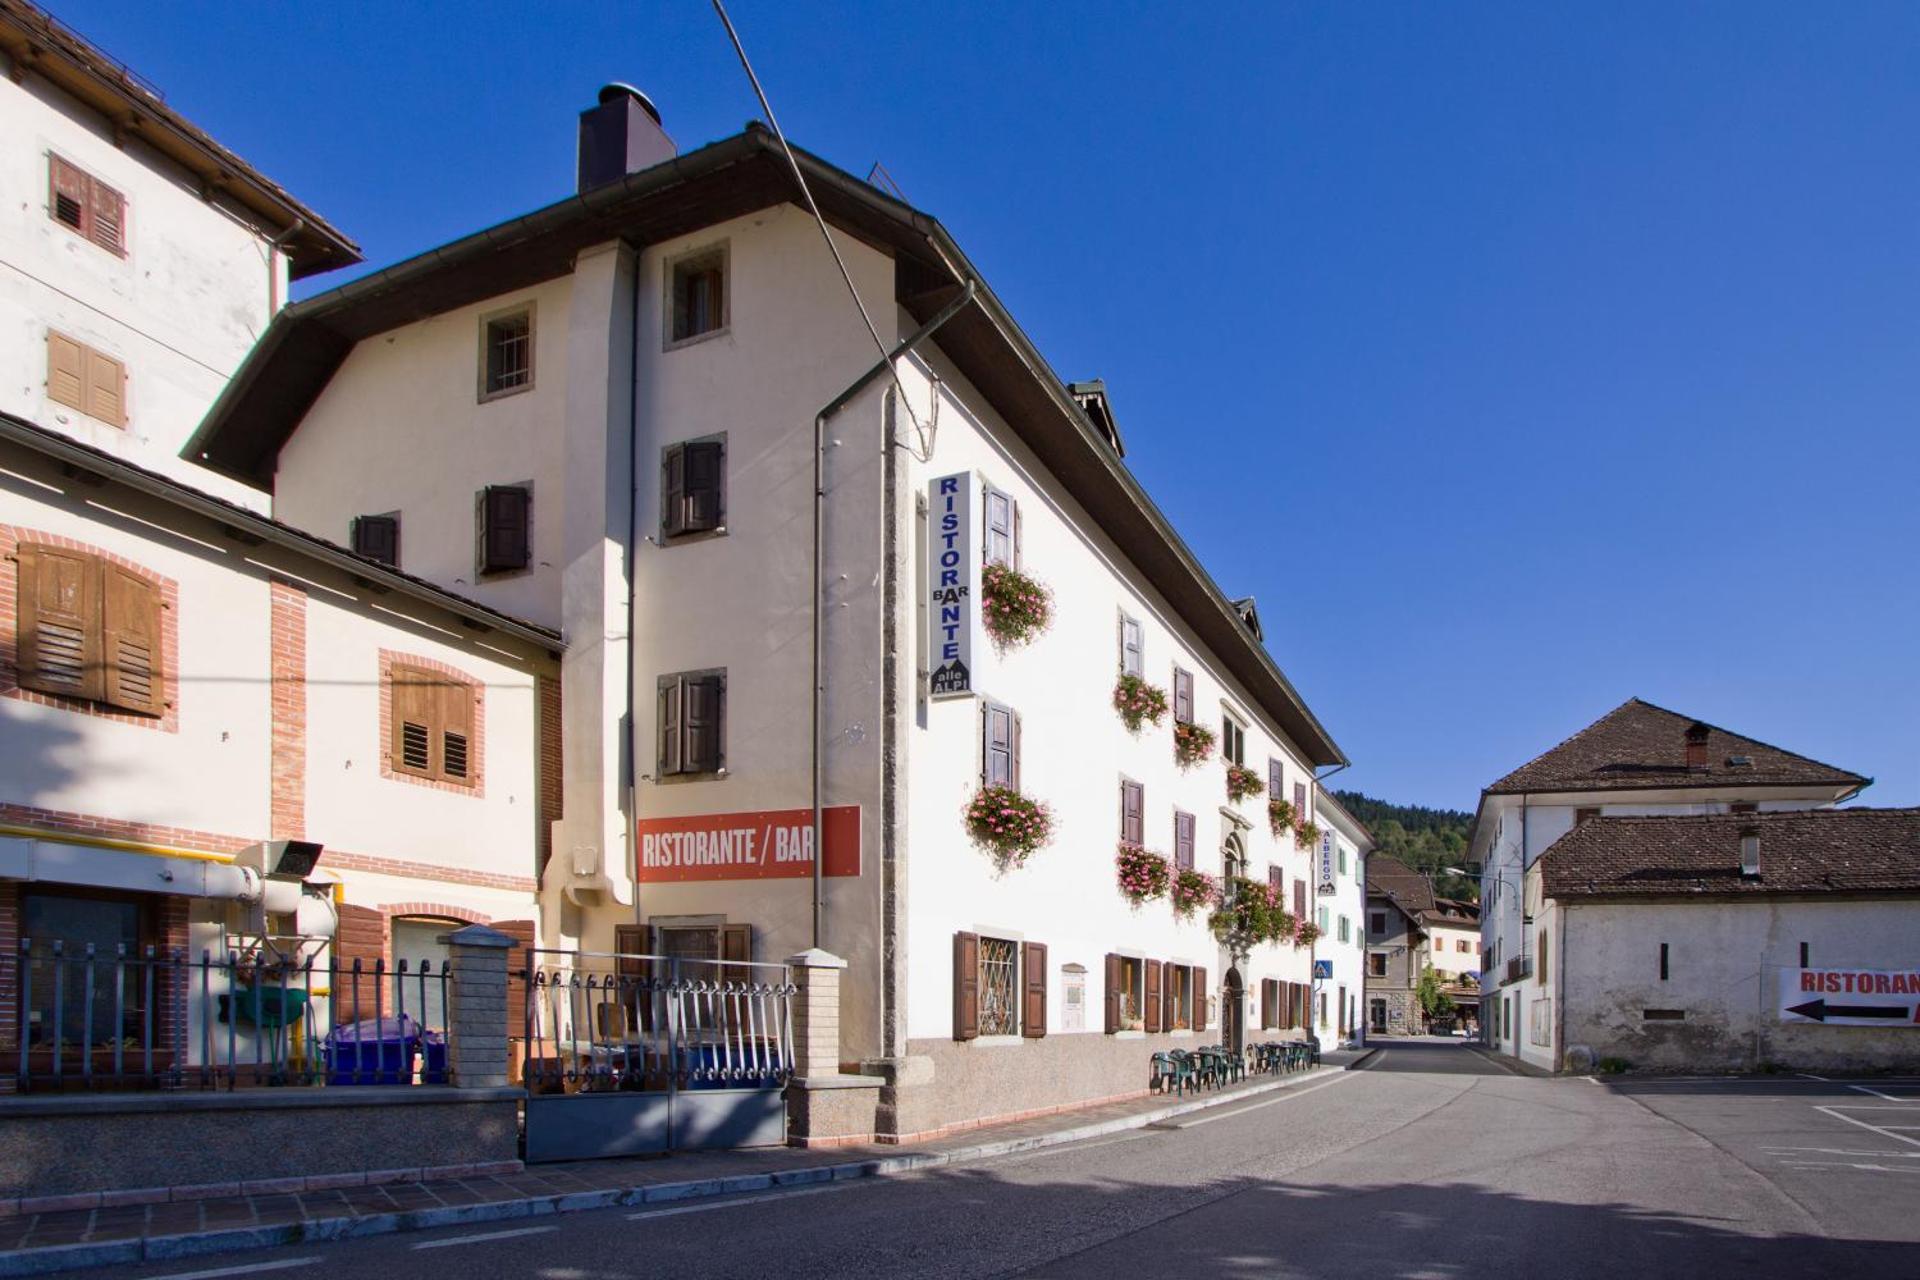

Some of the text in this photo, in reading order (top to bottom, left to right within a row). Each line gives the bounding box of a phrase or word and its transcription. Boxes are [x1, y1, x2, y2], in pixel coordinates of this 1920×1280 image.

[940, 477, 960, 660] RISTORANTE
[933, 586, 969, 606] BAR
[934, 679, 967, 693] ALPI
[938, 671, 962, 682] alle
[643, 829, 757, 867] RISTORANTE
